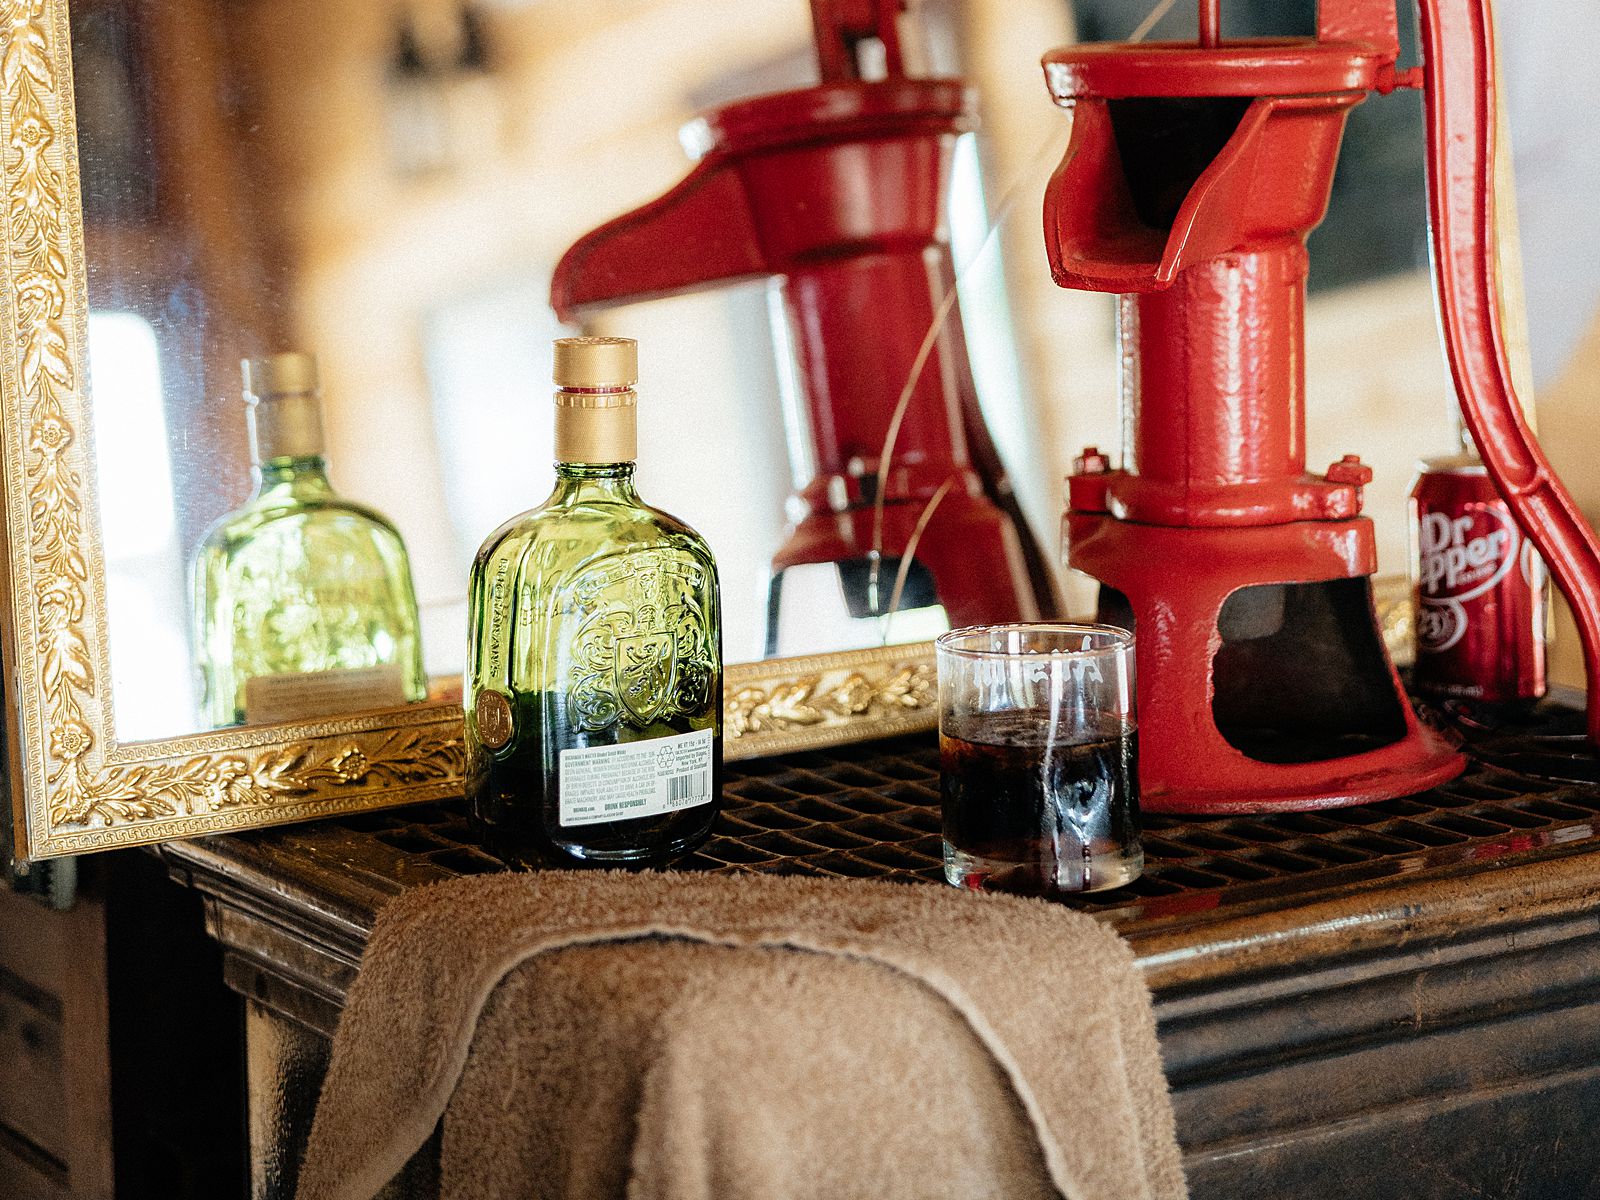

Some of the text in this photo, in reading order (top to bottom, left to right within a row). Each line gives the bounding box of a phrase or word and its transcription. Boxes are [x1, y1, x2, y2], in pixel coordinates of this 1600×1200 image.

[1420, 511, 1474, 551] Dr
[1420, 528, 1508, 595] pper
[605, 798, 646, 811] DRINK RESPONSIBLY
